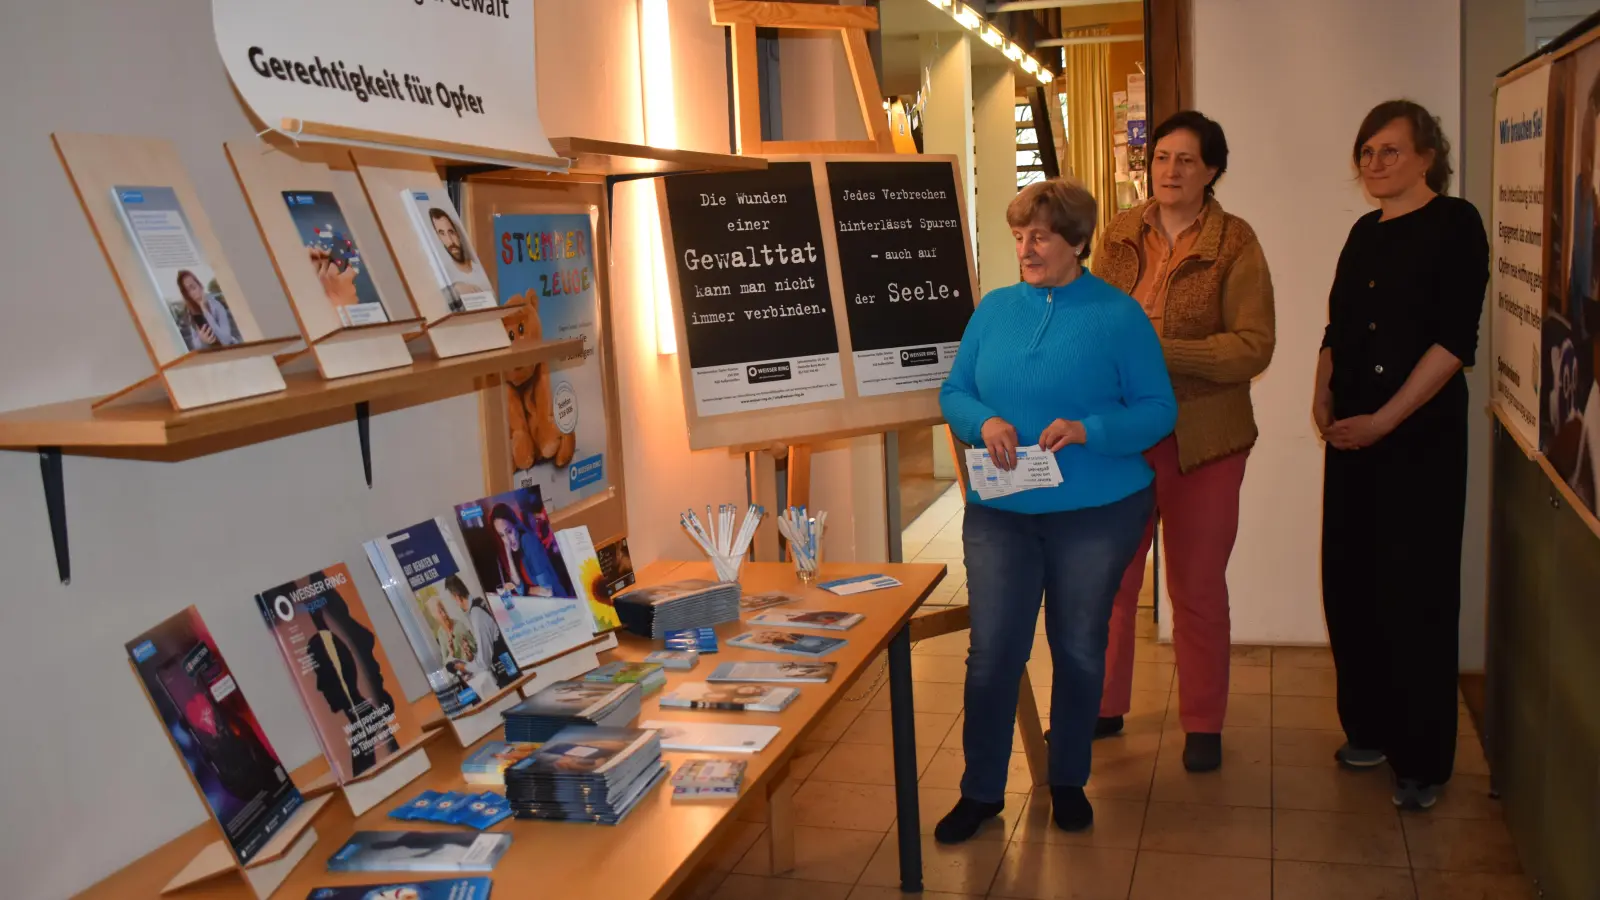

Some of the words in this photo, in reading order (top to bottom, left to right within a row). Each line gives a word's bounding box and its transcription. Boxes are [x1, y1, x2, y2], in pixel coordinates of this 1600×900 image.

[248, 46, 404, 102] Gerechtigkeit
[404, 73, 434, 105] für
[436, 82, 485, 117] Opfer
[700, 193, 727, 206] Die
[736, 192, 787, 205] Wunden
[843, 190, 876, 201] Jedes
[882, 189, 946, 200] Verbrechen
[727, 219, 770, 231] einer
[839, 218, 913, 232] hinterlässt
[919, 218, 957, 231] Spuren
[501, 230, 585, 264] STUMMER
[684, 242, 817, 271] Gewalttat
[885, 248, 912, 260] auch
[918, 247, 937, 258] auf
[539, 267, 590, 297] ZEUGE
[695, 285, 731, 298] kann
[740, 281, 767, 294] man
[775, 276, 815, 292] nicht
[855, 293, 876, 305] der
[887, 281, 960, 303] Seele.
[692, 311, 736, 325] immer
[744, 303, 826, 321] verbinden.
[757, 366, 777, 374] WEISSER
[778, 364, 790, 372] RING
[289, 579, 325, 602] WEISSER
[326, 573, 347, 588] RING
[361, 703, 391, 728] psychisch
